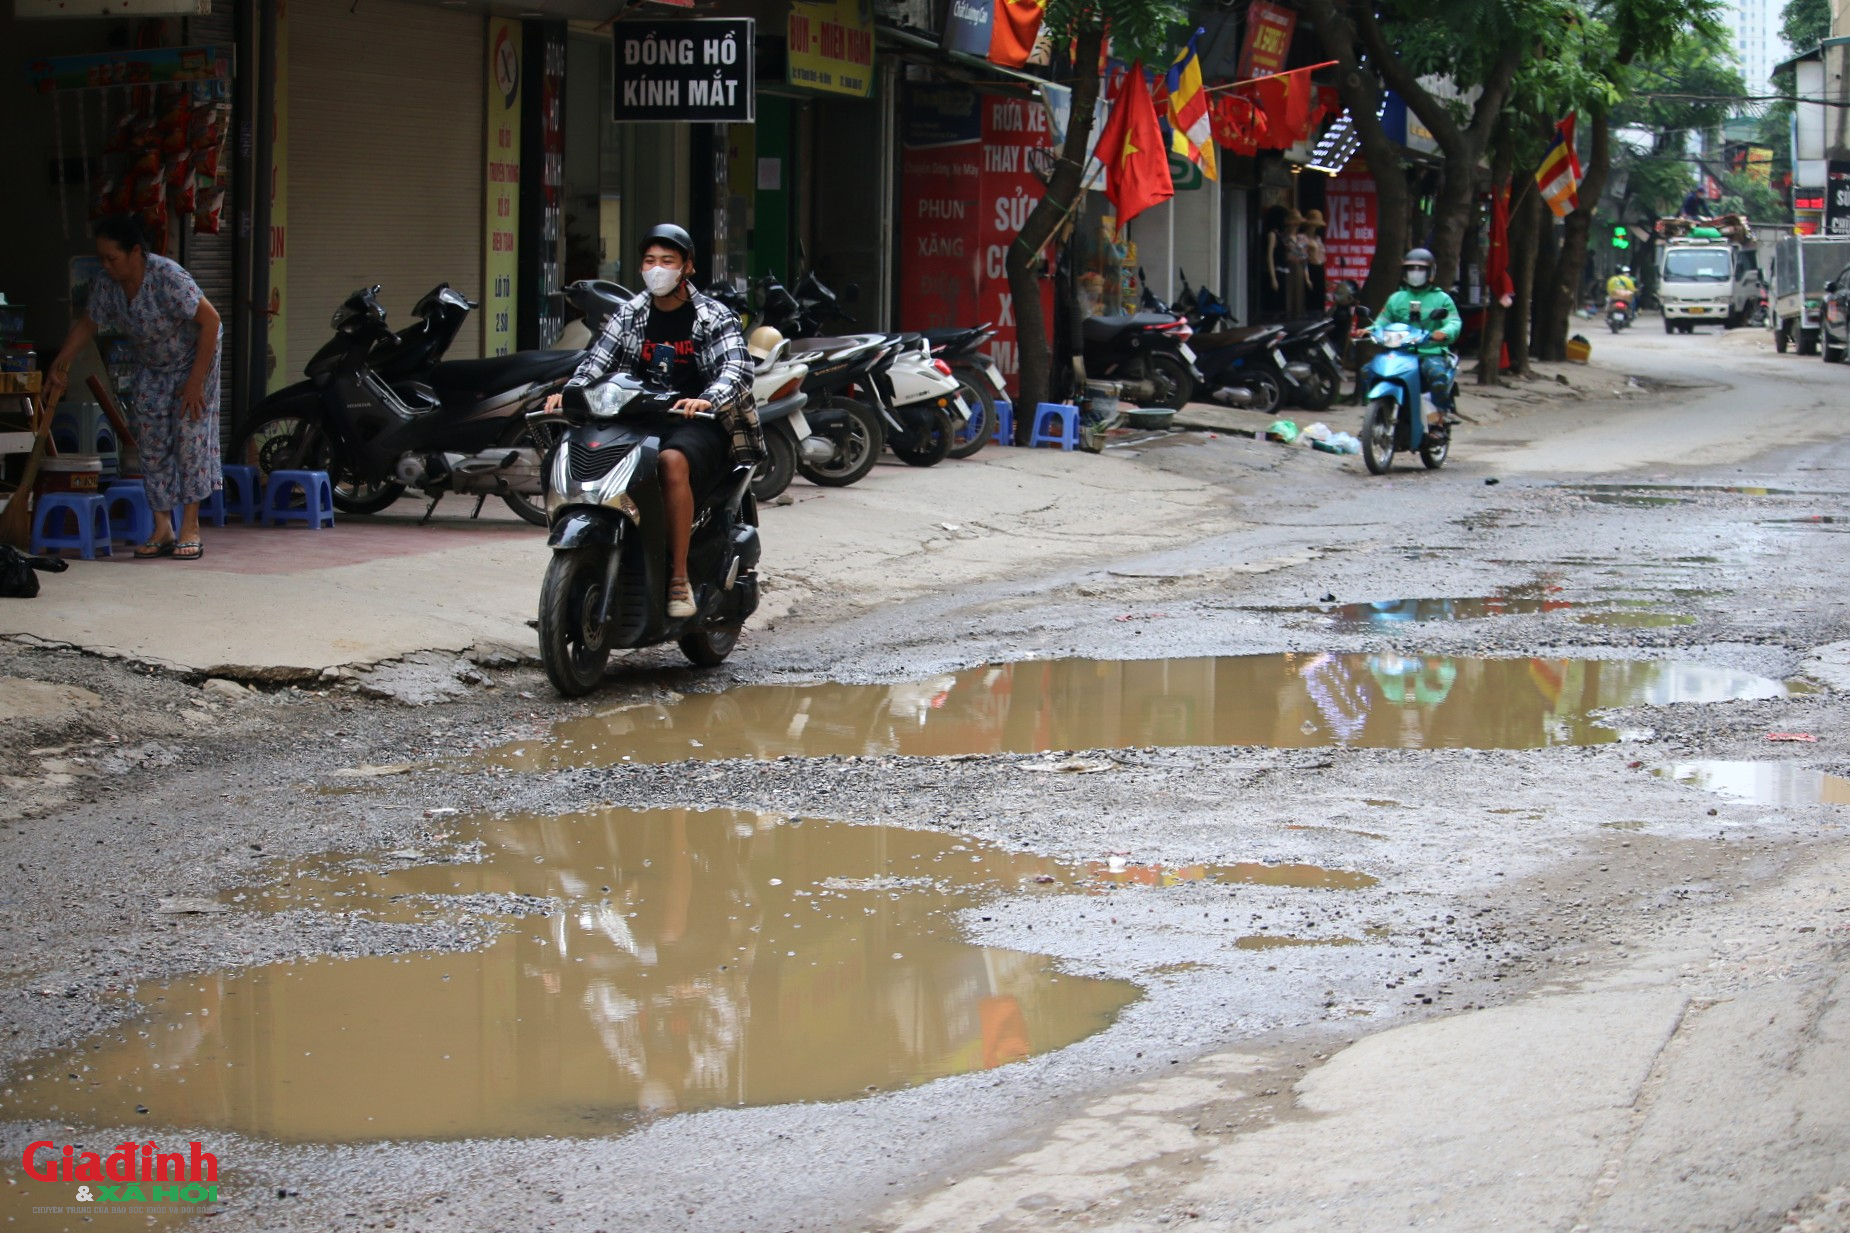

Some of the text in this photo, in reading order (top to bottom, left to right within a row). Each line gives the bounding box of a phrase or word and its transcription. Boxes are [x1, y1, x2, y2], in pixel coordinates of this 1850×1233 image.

[624, 29, 737, 66] ĐỒNG HỒ
[623, 68, 738, 107] KÍNH MẮT
[984, 144, 1020, 173] THAY
[918, 198, 965, 220] PHUN
[1326, 195, 1350, 239] XE
[917, 232, 965, 257] XĂNG
